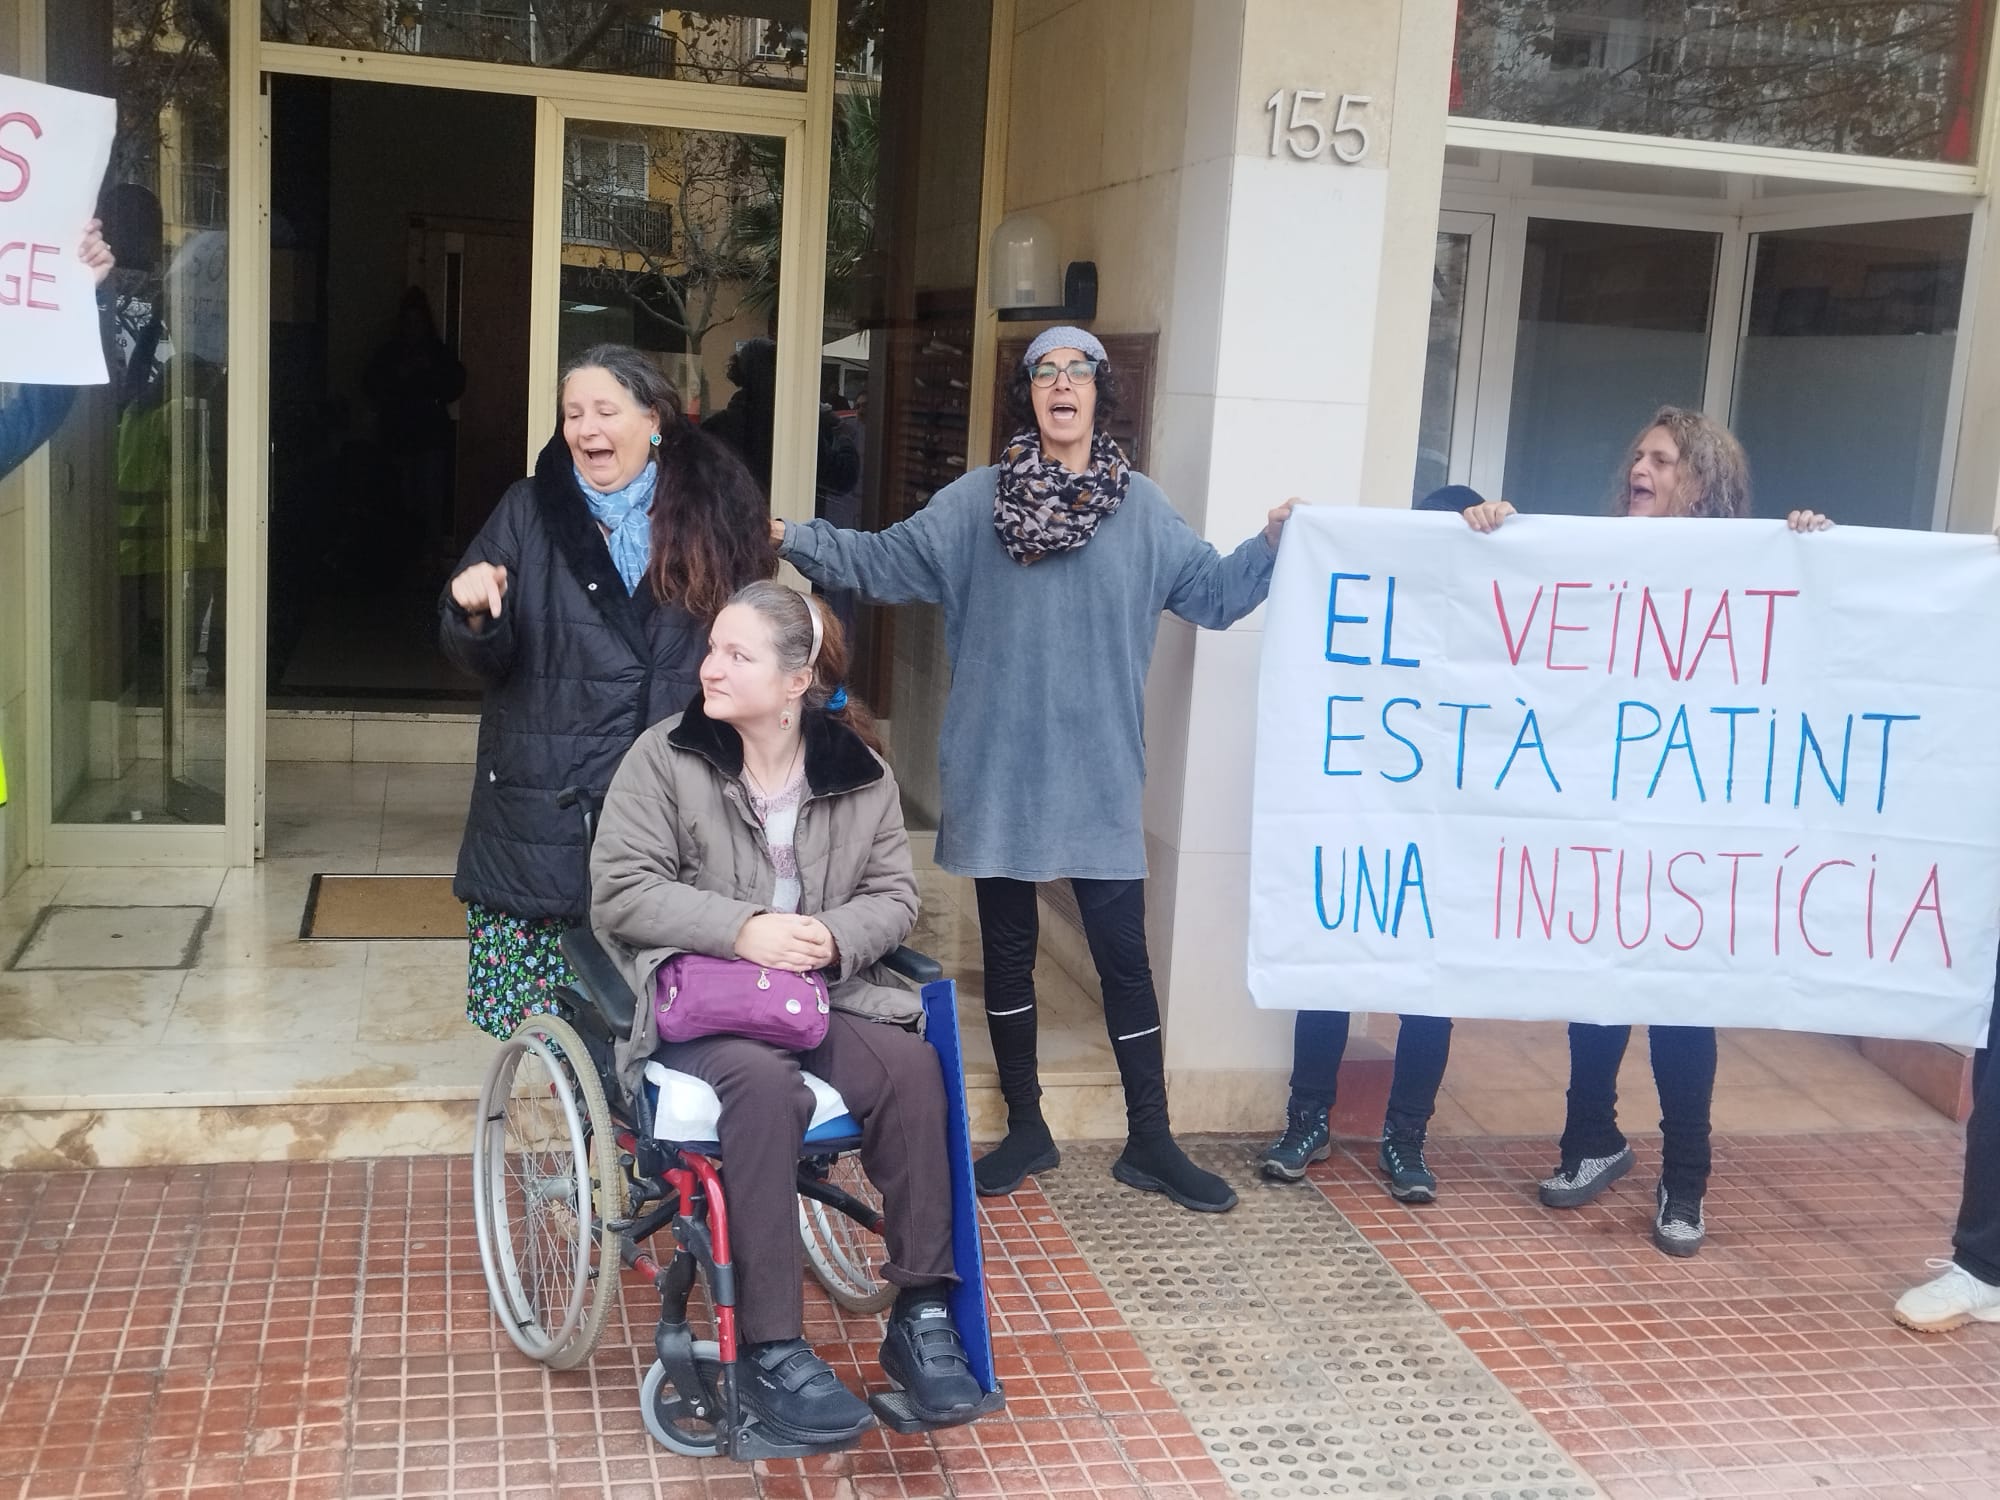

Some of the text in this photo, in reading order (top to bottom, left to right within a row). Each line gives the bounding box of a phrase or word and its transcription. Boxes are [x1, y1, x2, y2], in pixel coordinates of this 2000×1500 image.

[1266, 89, 1372, 163] 155
[1324, 572, 1801, 686] EL VEÏNAT
[1323, 695, 1562, 793] ESTÀ
[1313, 841, 1434, 939] UNA
